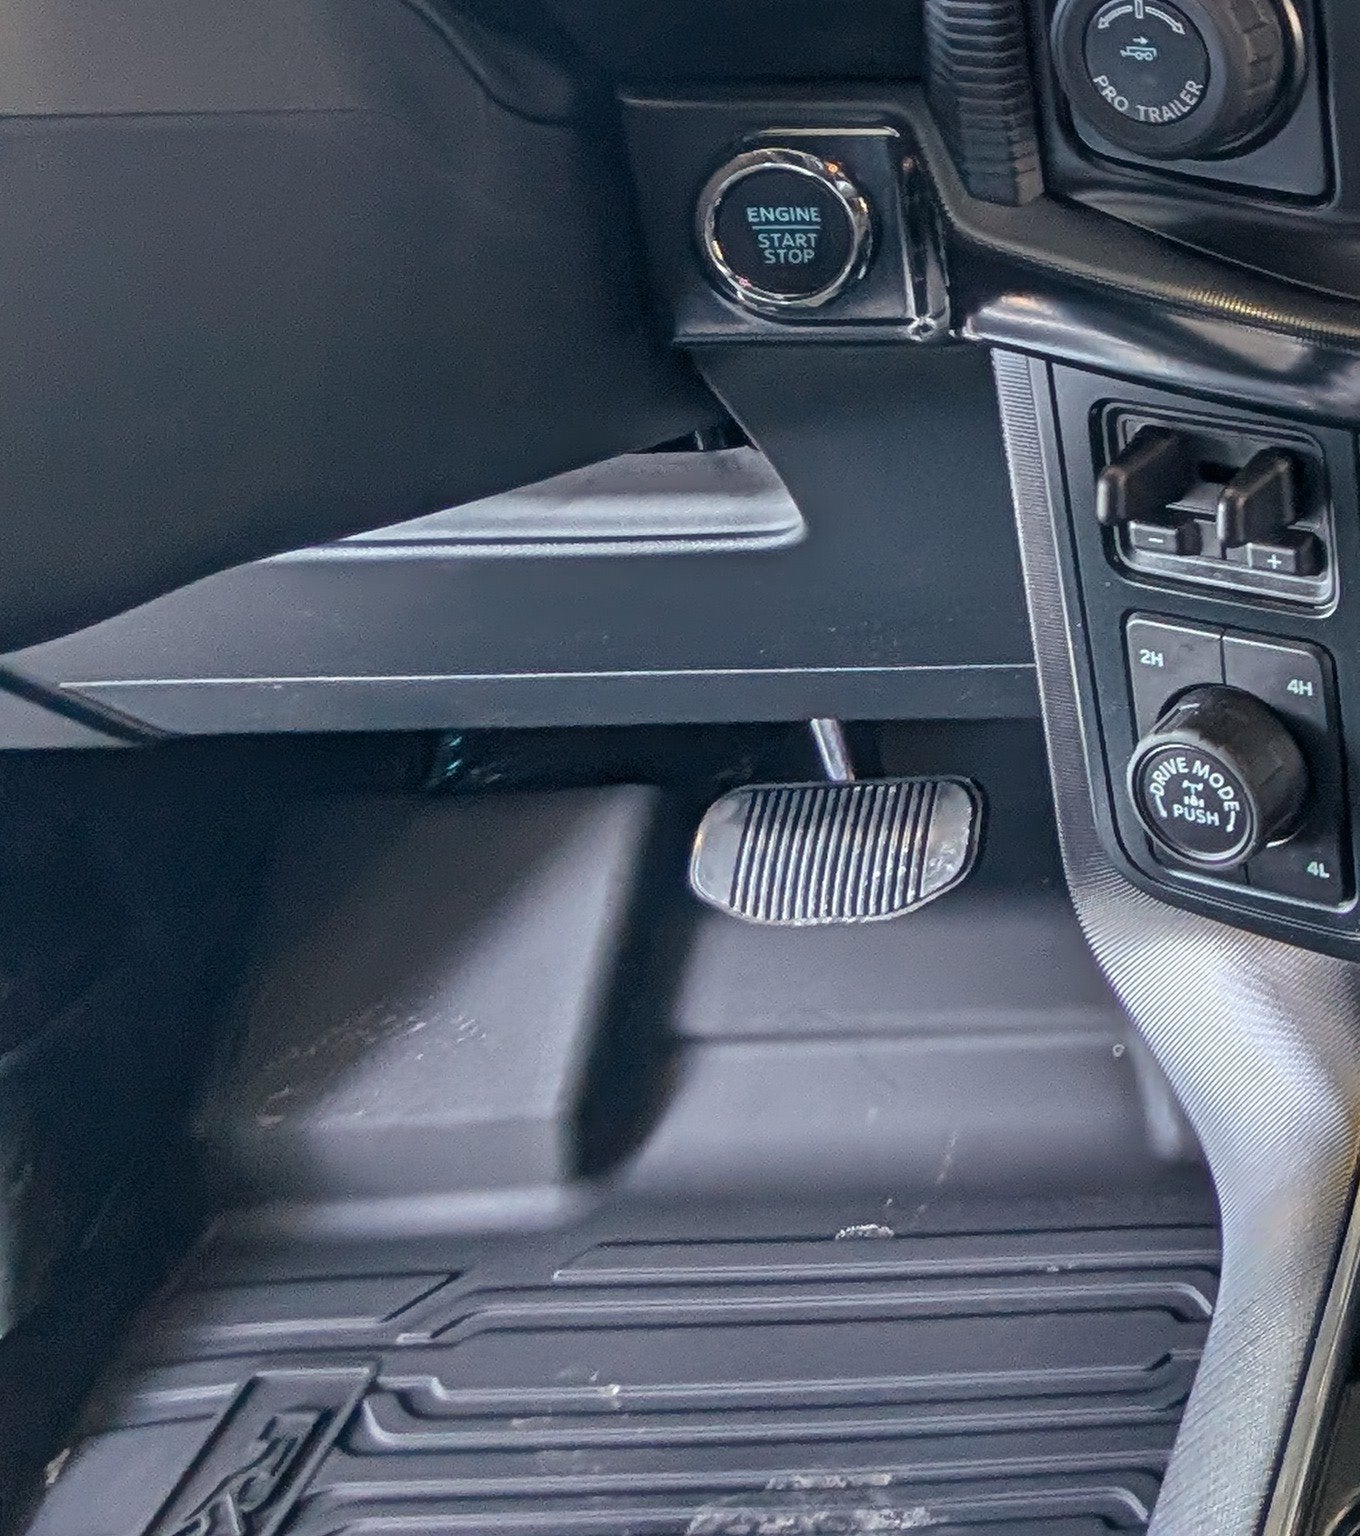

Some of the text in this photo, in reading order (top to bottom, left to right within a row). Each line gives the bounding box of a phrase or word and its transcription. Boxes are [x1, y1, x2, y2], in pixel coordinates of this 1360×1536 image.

[1092, 74, 1204, 123] PRO TRAILER
[747, 206, 821, 223] ENGINE
[757, 232, 817, 248] START
[763, 248, 815, 264] STOP
[1139, 649, 1164, 668] 2H
[1286, 678, 1313, 697] 4H
[1150, 757, 1241, 812] DRIVE MODE
[1173, 803, 1220, 827] PUSH
[1307, 861, 1330, 879] 4L
